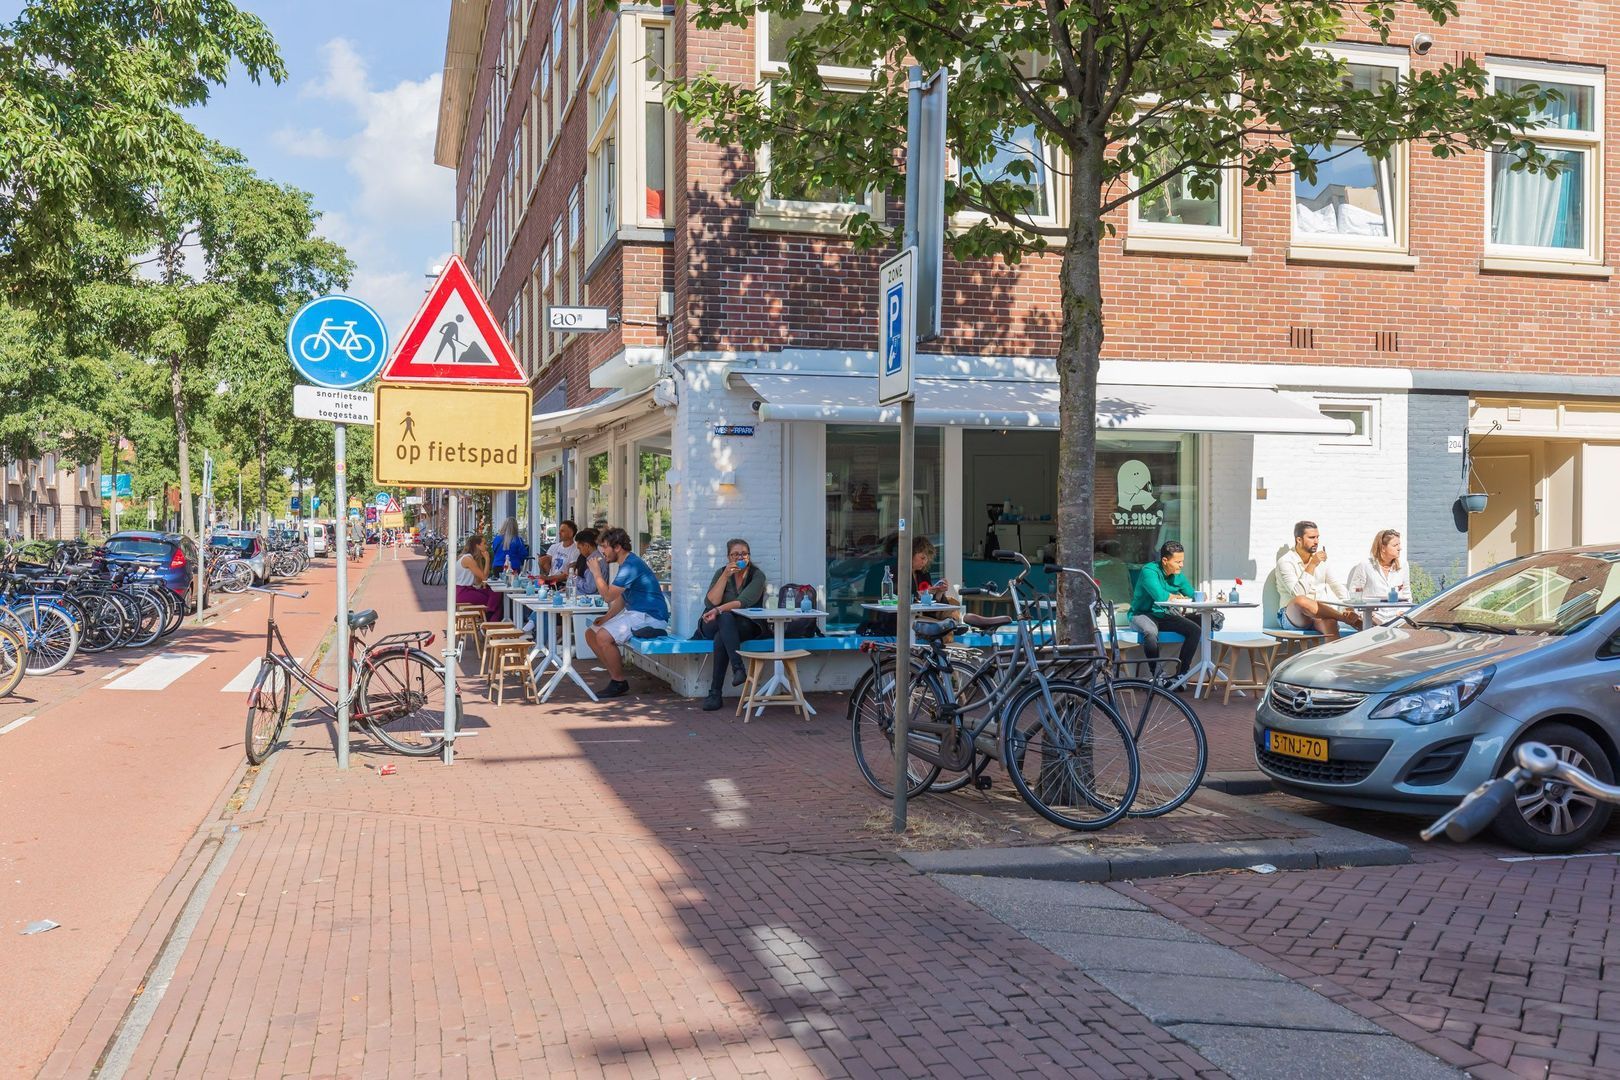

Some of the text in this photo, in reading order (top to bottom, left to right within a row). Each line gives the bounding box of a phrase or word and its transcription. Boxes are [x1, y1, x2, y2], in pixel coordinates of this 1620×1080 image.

[888, 264, 903, 284] ZONE
[889, 294, 900, 338] P
[316, 391, 368, 402] snorfietsen
[335, 402, 353, 410] niet
[319, 410, 369, 421] toegestaan
[714, 426, 754, 435] WESRPARK
[1449, 440, 1462, 449] 204
[396, 441, 518, 467] op fietspad
